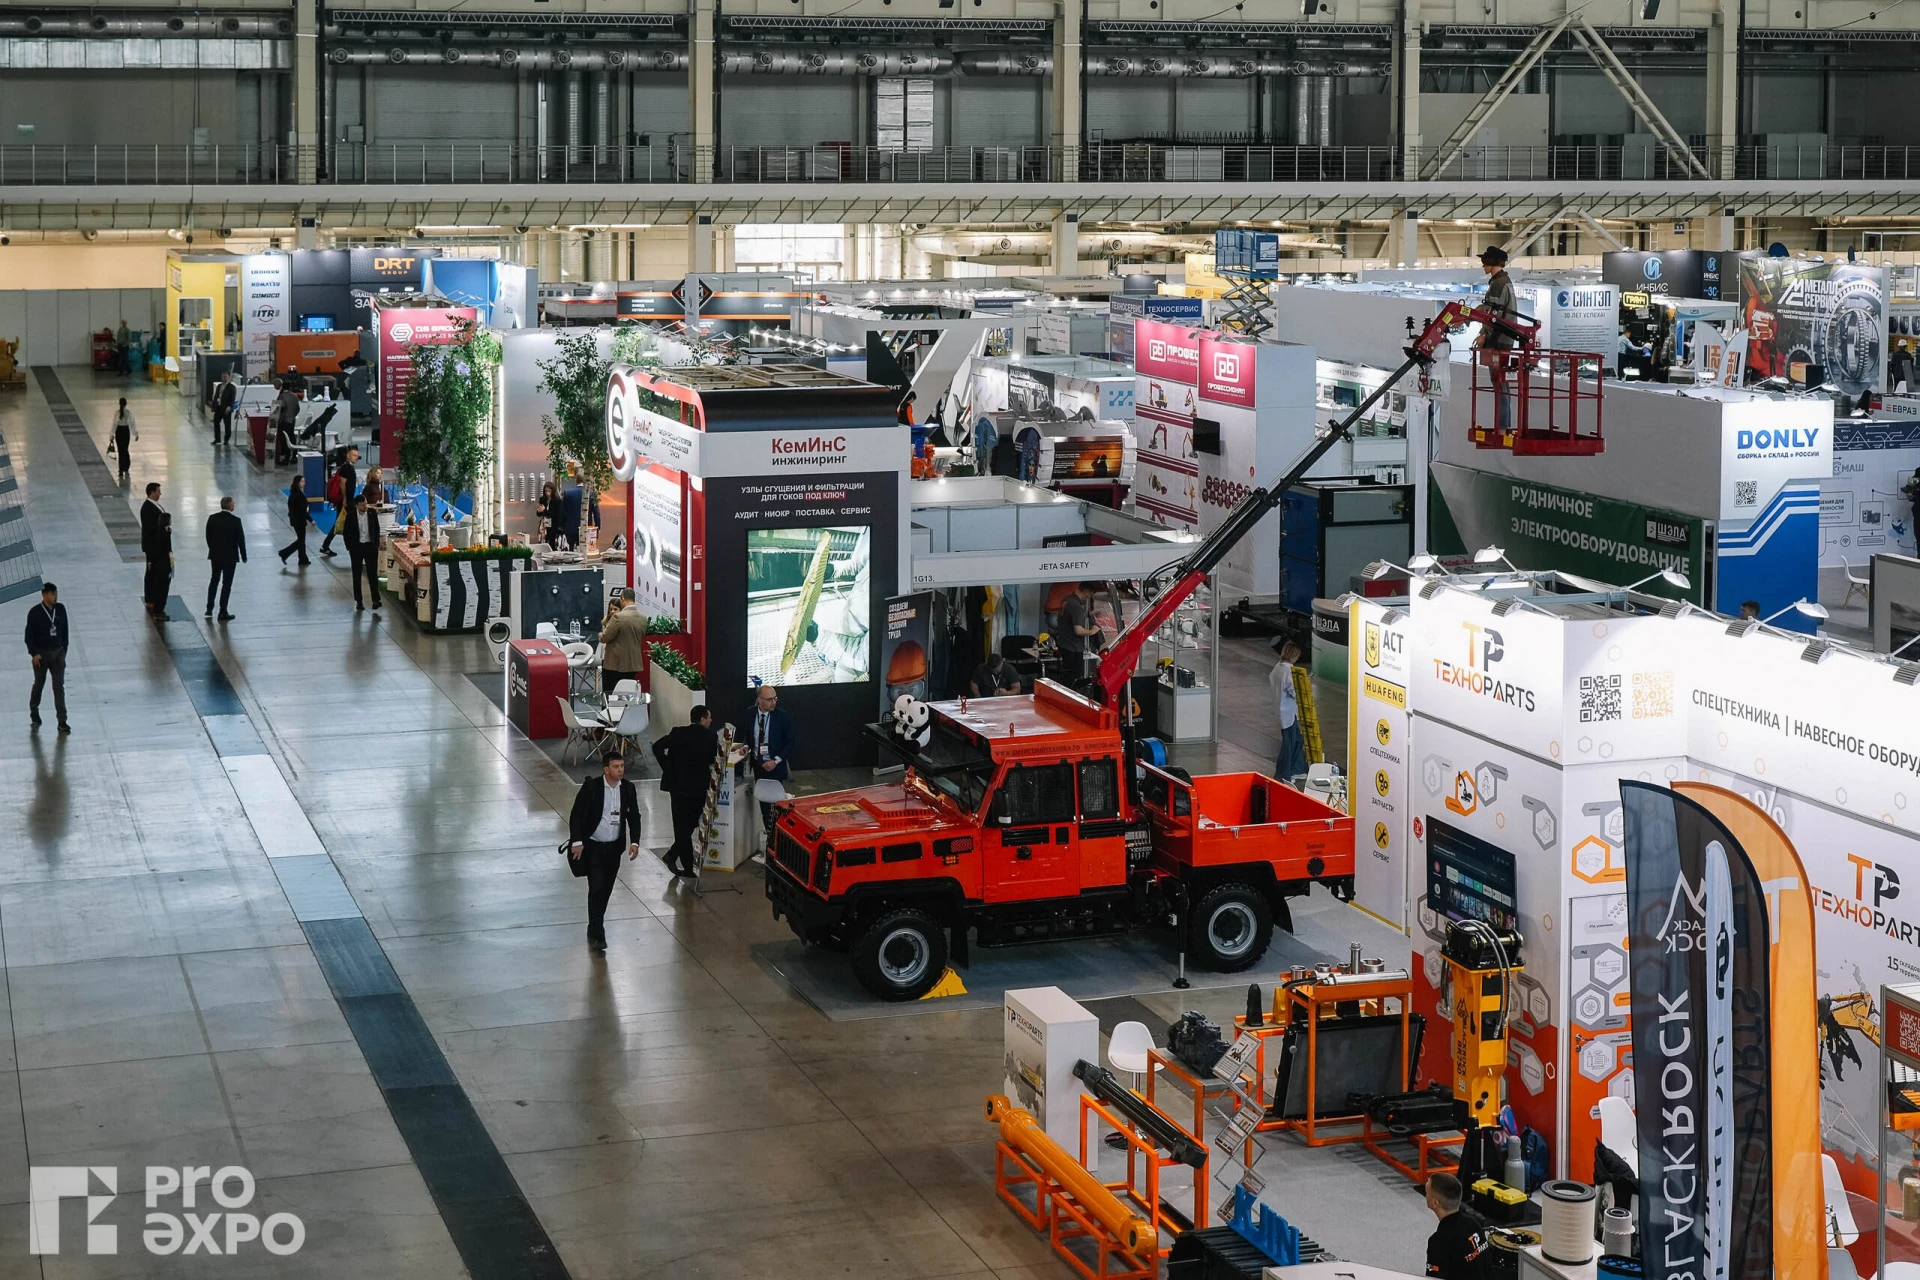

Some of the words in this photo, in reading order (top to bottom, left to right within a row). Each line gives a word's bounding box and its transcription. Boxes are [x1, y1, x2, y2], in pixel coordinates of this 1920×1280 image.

[374, 258, 415, 270] DRT
[1637, 283, 1669, 292] ИНБИС
[1111, 300, 1143, 314] ТЕХНОСЕРВИС
[1573, 291, 1611, 308] СИНТЭП
[1893, 404, 1917, 415] ЕВРАЗ
[771, 436, 846, 453] КемИнС
[1737, 428, 1819, 449] DONLY
[772, 455, 847, 466] инжиниринг
[741, 486, 762, 494] УЗЛЫ
[764, 484, 806, 493] СГУЩЕНИЯ
[814, 482, 865, 491] ФИЛЬТРАЦИИ
[761, 493, 777, 502] ДЛЯ
[779, 493, 803, 501] ГОКОВ
[805, 492, 821, 500] ПОД
[823, 491, 845, 499] КЛЮЧ
[1511, 485, 1594, 518] РУДНИЧНОЕ
[734, 511, 759, 519] АУДИТ
[764, 510, 790, 518] НИОКР
[795, 508, 835, 516] ПОСТАВКА
[841, 507, 871, 515] СЕРВИС
[1657, 522, 1686, 540] ШЭЛА
[1511, 517, 1690, 575] ЭЛЕКТРООБОРУДОВАНИЕ
[1039, 563, 1058, 571] JETA
[1382, 630, 1404, 653] АСТ
[1366, 681, 1403, 703] HUAFENG
[1434, 658, 1535, 712] ТЕХНОPARTS
[1692, 689, 1780, 730] СПЕЦТЕХНИКА
[1794, 719, 1865, 756] НАВЕСНОЕ
[1370, 746, 1401, 765] СПЕЦТЕХНИКА
[1372, 797, 1394, 813] ЗАПЧАСТИ
[1373, 850, 1389, 863] СЕРВИС
[1887, 956, 1899, 970] 15
